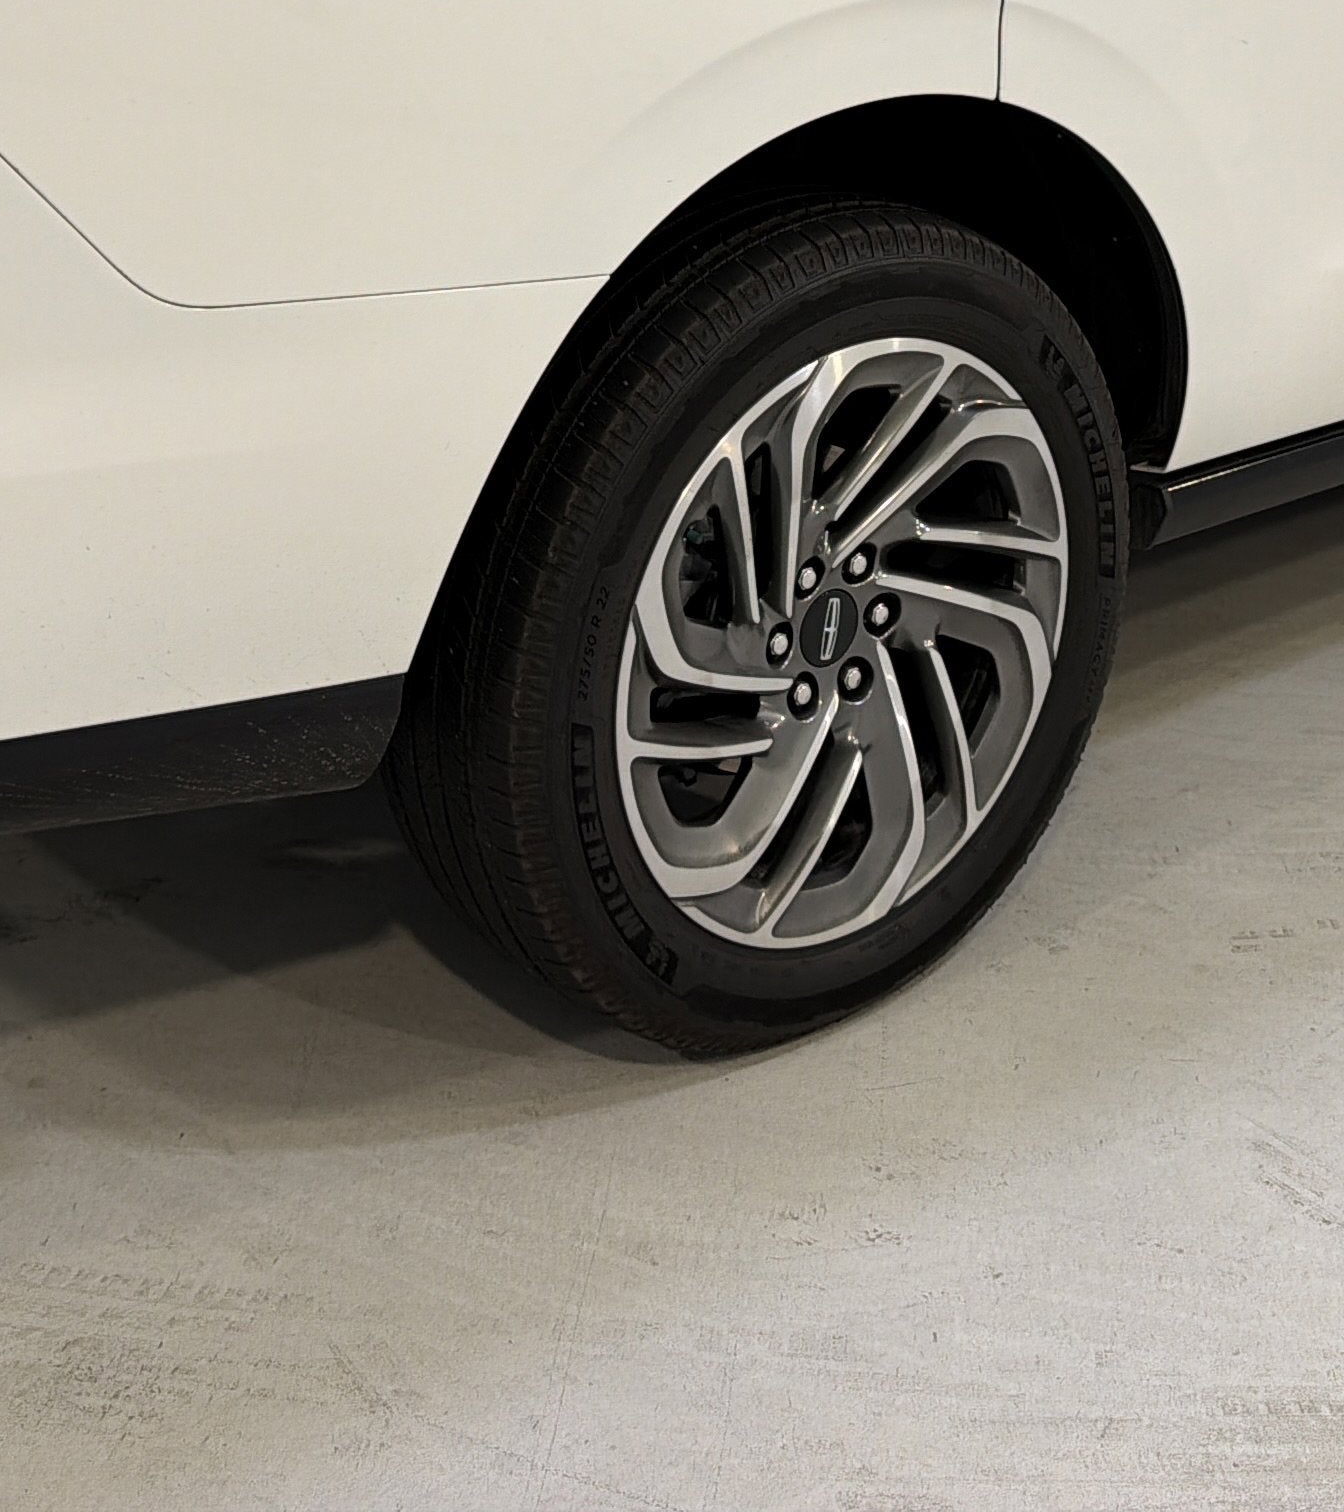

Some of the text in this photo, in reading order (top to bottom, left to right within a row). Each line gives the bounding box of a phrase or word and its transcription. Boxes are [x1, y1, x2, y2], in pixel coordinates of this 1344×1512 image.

[1063, 382, 1116, 567] MICHELIN
[576, 586, 610, 702] 275/50 R 22
